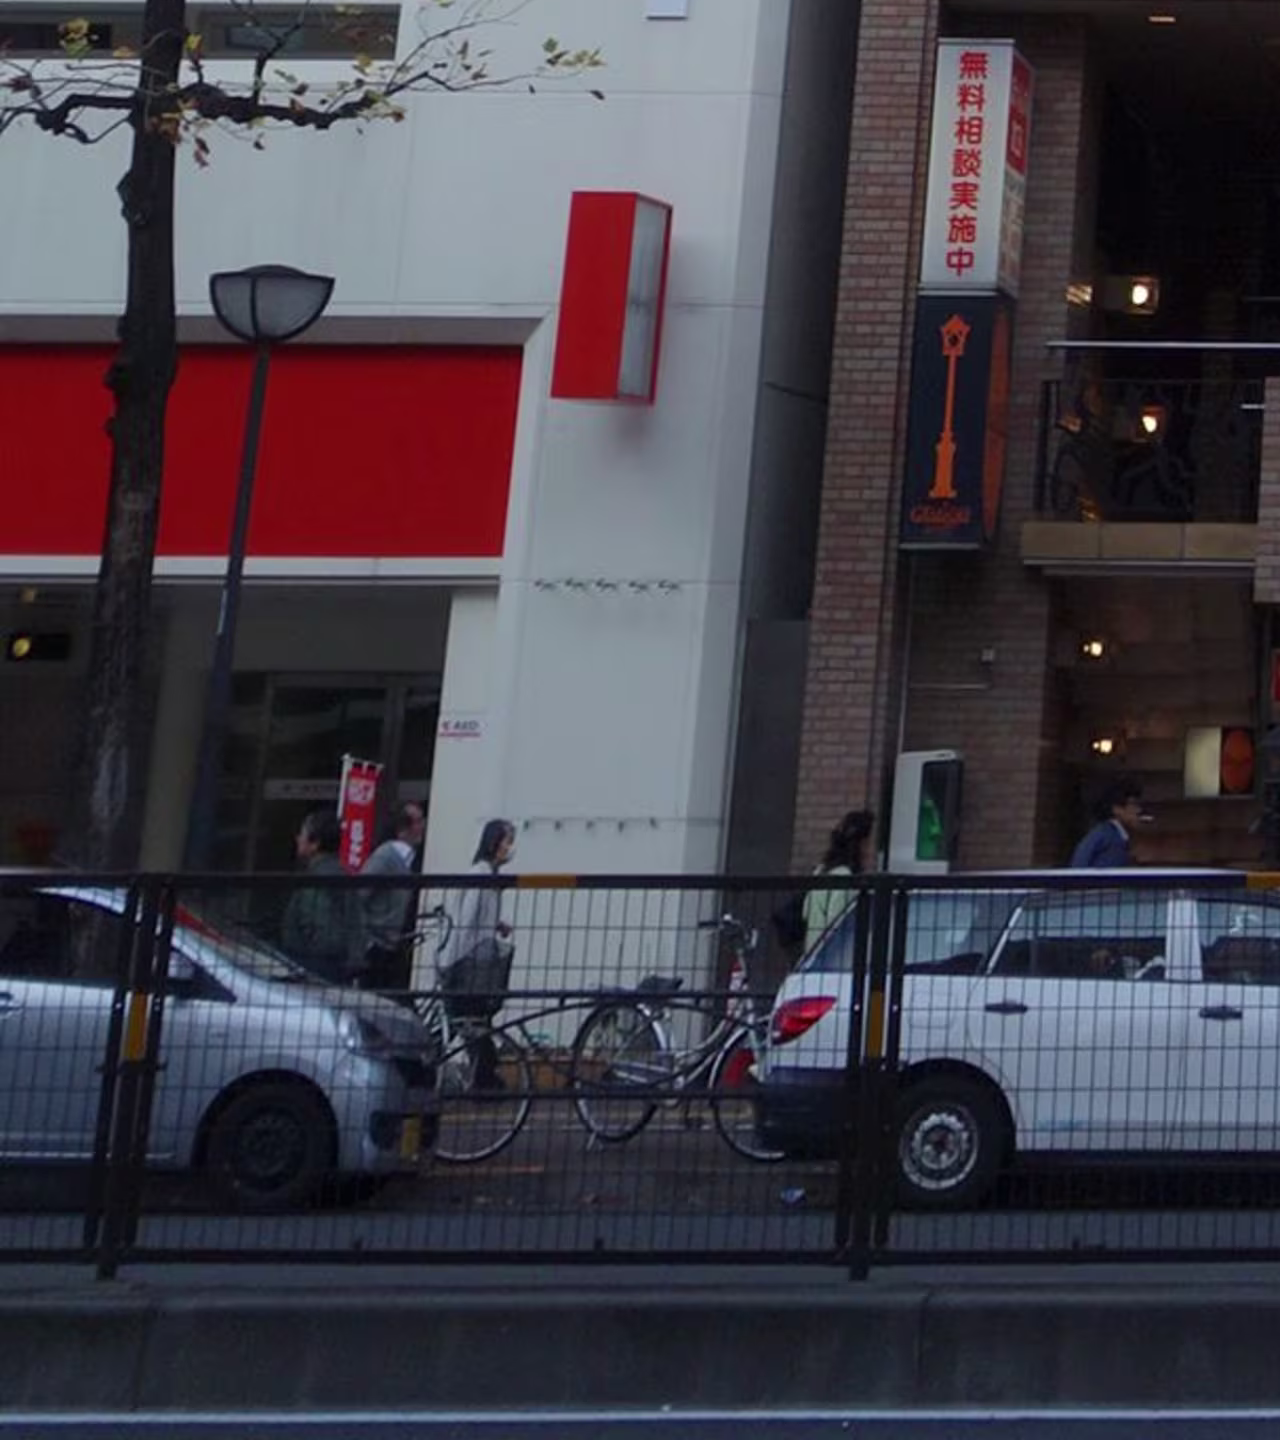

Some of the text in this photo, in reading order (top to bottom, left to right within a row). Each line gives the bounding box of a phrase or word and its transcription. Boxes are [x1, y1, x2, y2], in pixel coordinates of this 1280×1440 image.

[945, 49, 989, 278] 無料相談実施中
